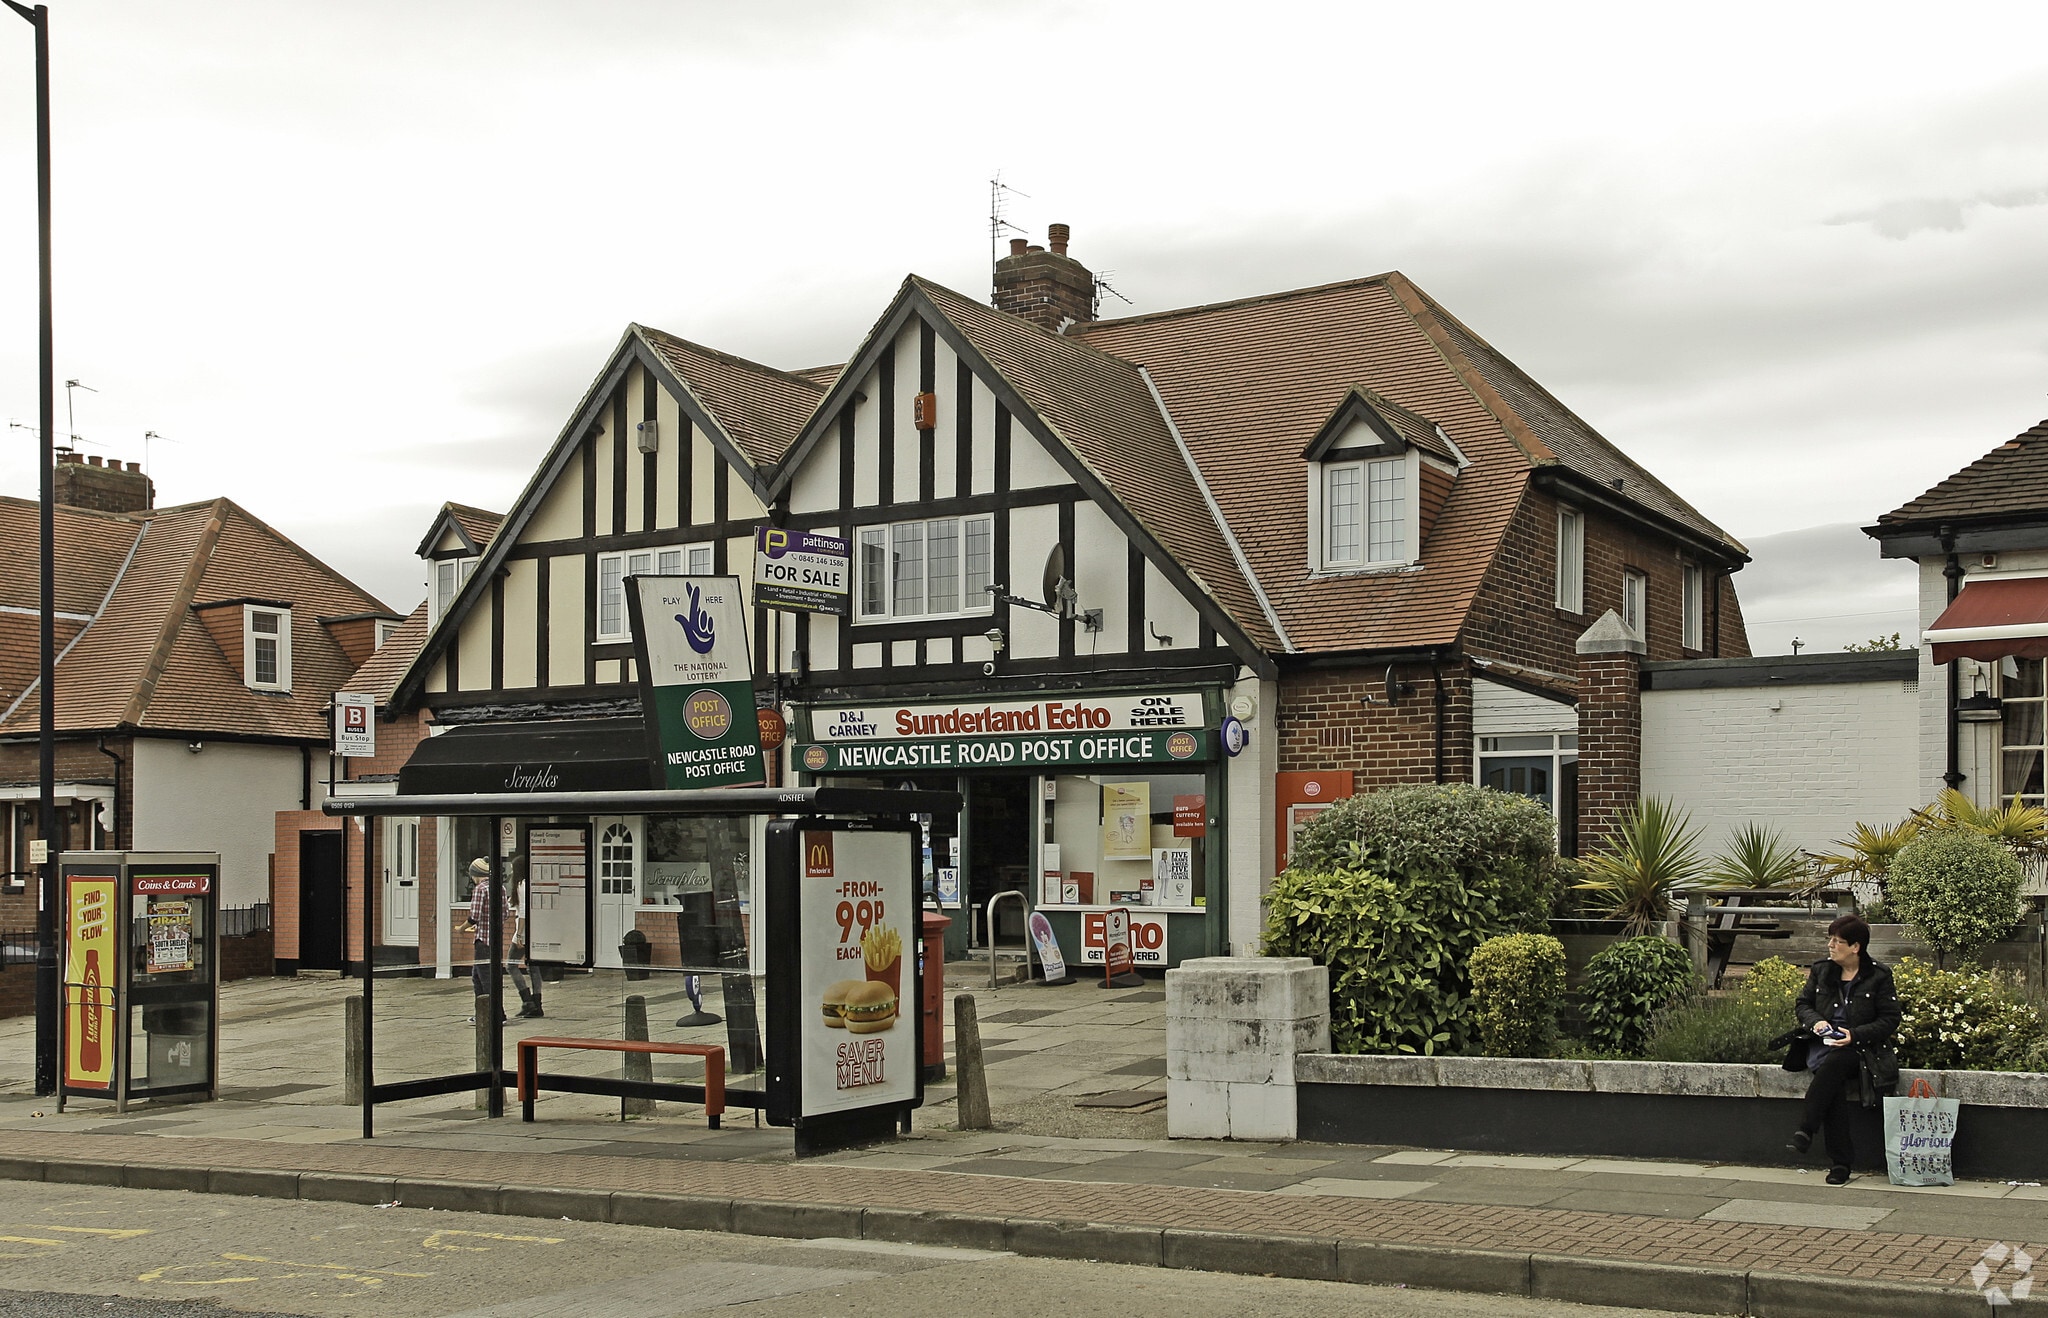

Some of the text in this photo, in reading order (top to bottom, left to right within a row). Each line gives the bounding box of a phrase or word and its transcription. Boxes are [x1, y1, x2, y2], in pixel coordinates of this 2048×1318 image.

[802, 537, 845, 550] pattinson
[817, 548, 845, 556] commercial
[798, 554, 844, 568] 0845 146 1586
[764, 563, 841, 588] FOR SALE
[662, 596, 723, 605] PLAY HERE
[778, 593, 826, 604] Investment Business
[782, 587, 795, 595] Retail
[798, 589, 819, 597] Industrial
[822, 592, 838, 600] Offices
[673, 662, 728, 672] THE NATIONAL
[686, 671, 719, 681] LOTTERY
[693, 699, 719, 713] POST
[1140, 697, 1172, 706] ON
[349, 708, 362, 724] B
[839, 710, 865, 723] D&J
[895, 702, 1112, 735] Sunderland Echo
[1130, 706, 1184, 717] SALE
[691, 714, 727, 728] OFFICE
[1130, 716, 1186, 727] HERE
[760, 731, 781, 742] FFICE
[828, 723, 877, 737] CARNEY
[355, 734, 370, 742] Stop
[1172, 737, 1189, 745] POST
[667, 744, 756, 765] NEWCASTLE ROAD
[839, 736, 1153, 768] NEWCASTLE ROAD POST OFFICE
[1170, 745, 1193, 753] OFFICE
[685, 760, 746, 778] POST OFFICE
[504, 764, 559, 793] Scruples
[777, 793, 805, 802] ADSHEL
[647, 868, 709, 889] Scruples
[942, 870, 953, 880] 16
[138, 879, 197, 890] Coins & Cards
[83, 890, 101, 905] FIND
[83, 907, 102, 923] YOUR
[835, 899, 885, 944] 99p
[81, 924, 103, 941] FLOW
[1084, 913, 1164, 950] Eo
[155, 940, 169, 948] SOUTH
[836, 946, 862, 960] EACH
[1087, 950, 1104, 960] GET
[1131, 951, 1160, 961] VERED
[836, 1038, 885, 1065] SAVER
[836, 1061, 885, 1090] MENU
[1899, 1109, 1954, 1134] FOOD
